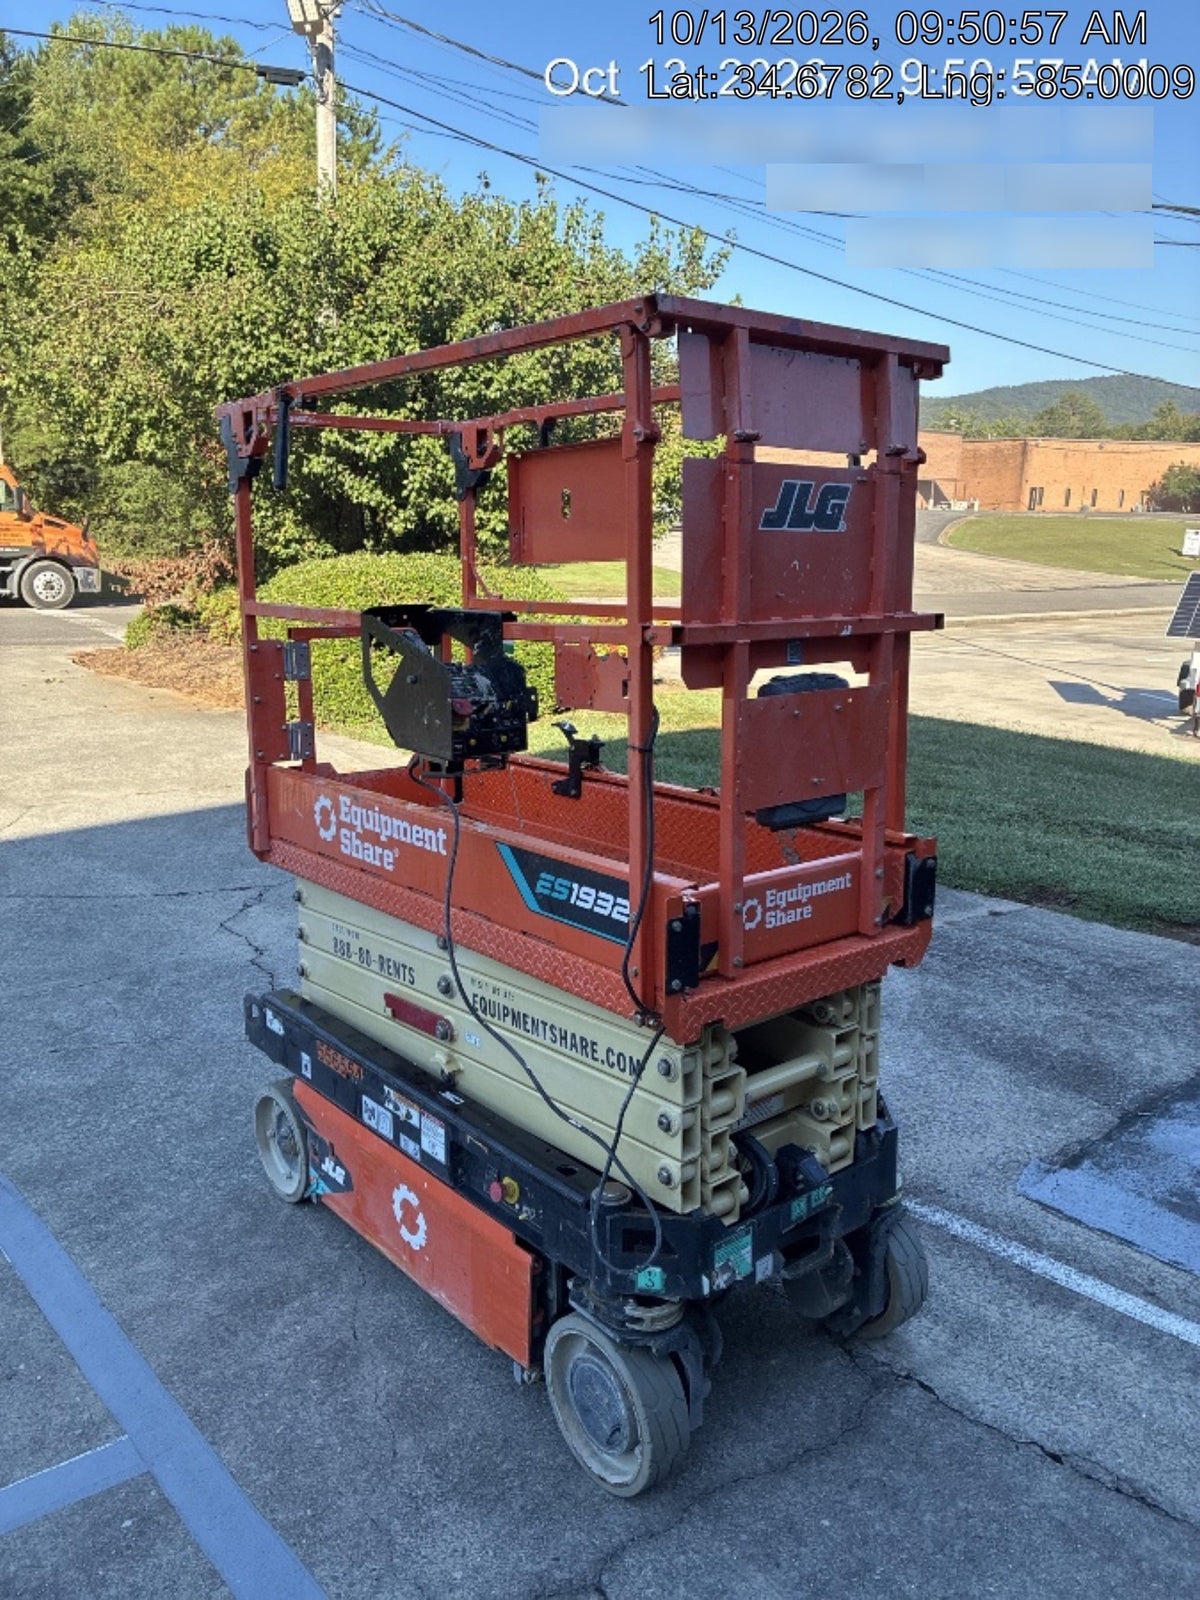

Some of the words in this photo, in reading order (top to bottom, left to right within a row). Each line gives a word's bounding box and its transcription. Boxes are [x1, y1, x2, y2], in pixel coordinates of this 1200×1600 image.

[758, 479, 852, 532] JLG
[338, 794, 448, 856] Equipment
[339, 828, 396, 872] Share
[535, 872, 631, 923] ES1932
[765, 872, 852, 909] Equipment
[765, 904, 813, 930] Share
[472, 993, 645, 1081] EQUIPMENTSHARE.COM
